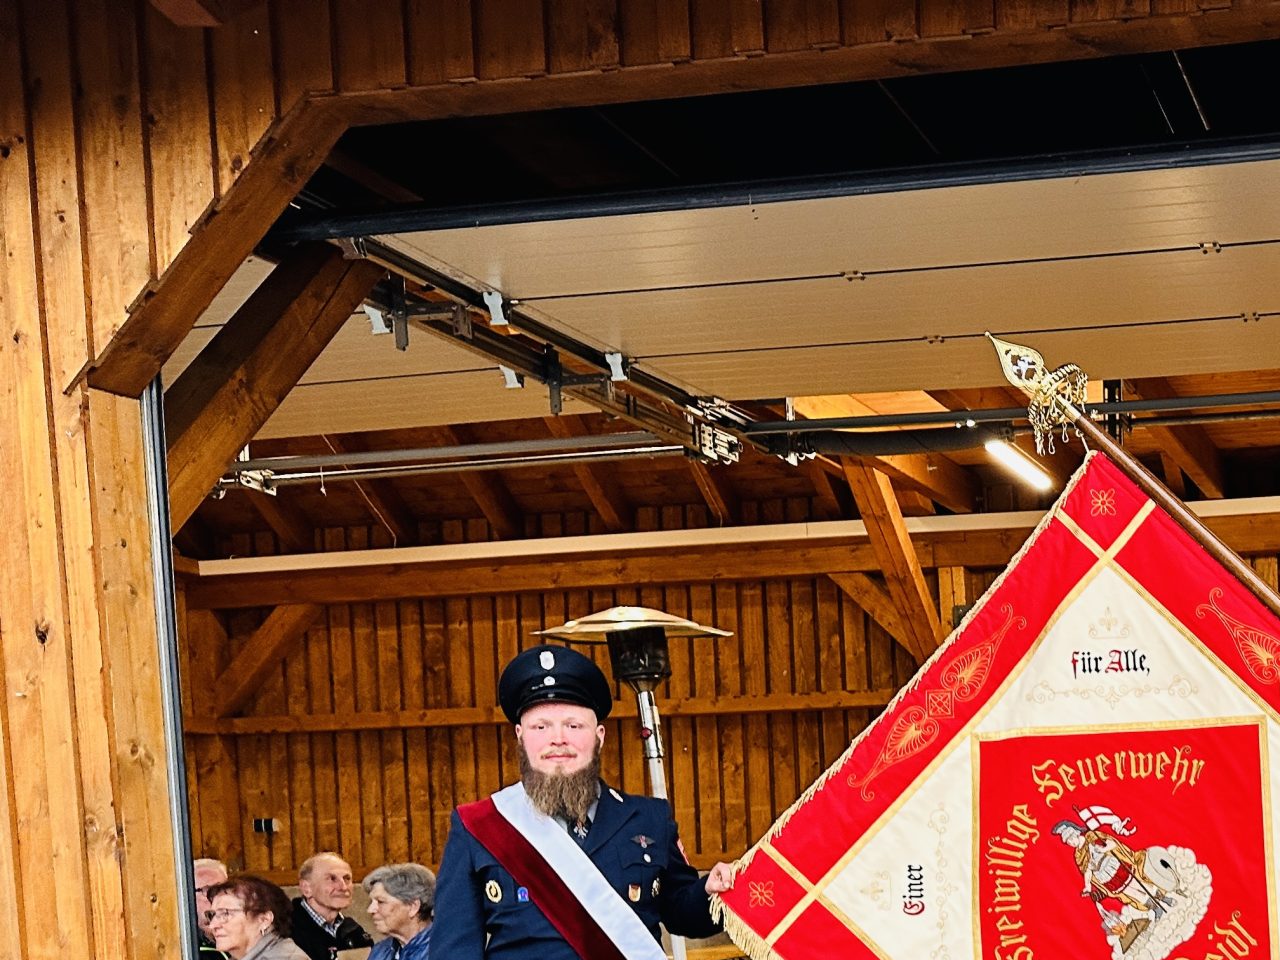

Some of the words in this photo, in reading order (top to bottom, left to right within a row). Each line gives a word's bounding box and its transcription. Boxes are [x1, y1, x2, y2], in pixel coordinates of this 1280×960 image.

[1071, 650, 1103, 680] für
[1104, 649, 1150, 676] Alle,
[1031, 744, 1206, 808] Feuerwehr
[902, 864, 925, 916] Einer
